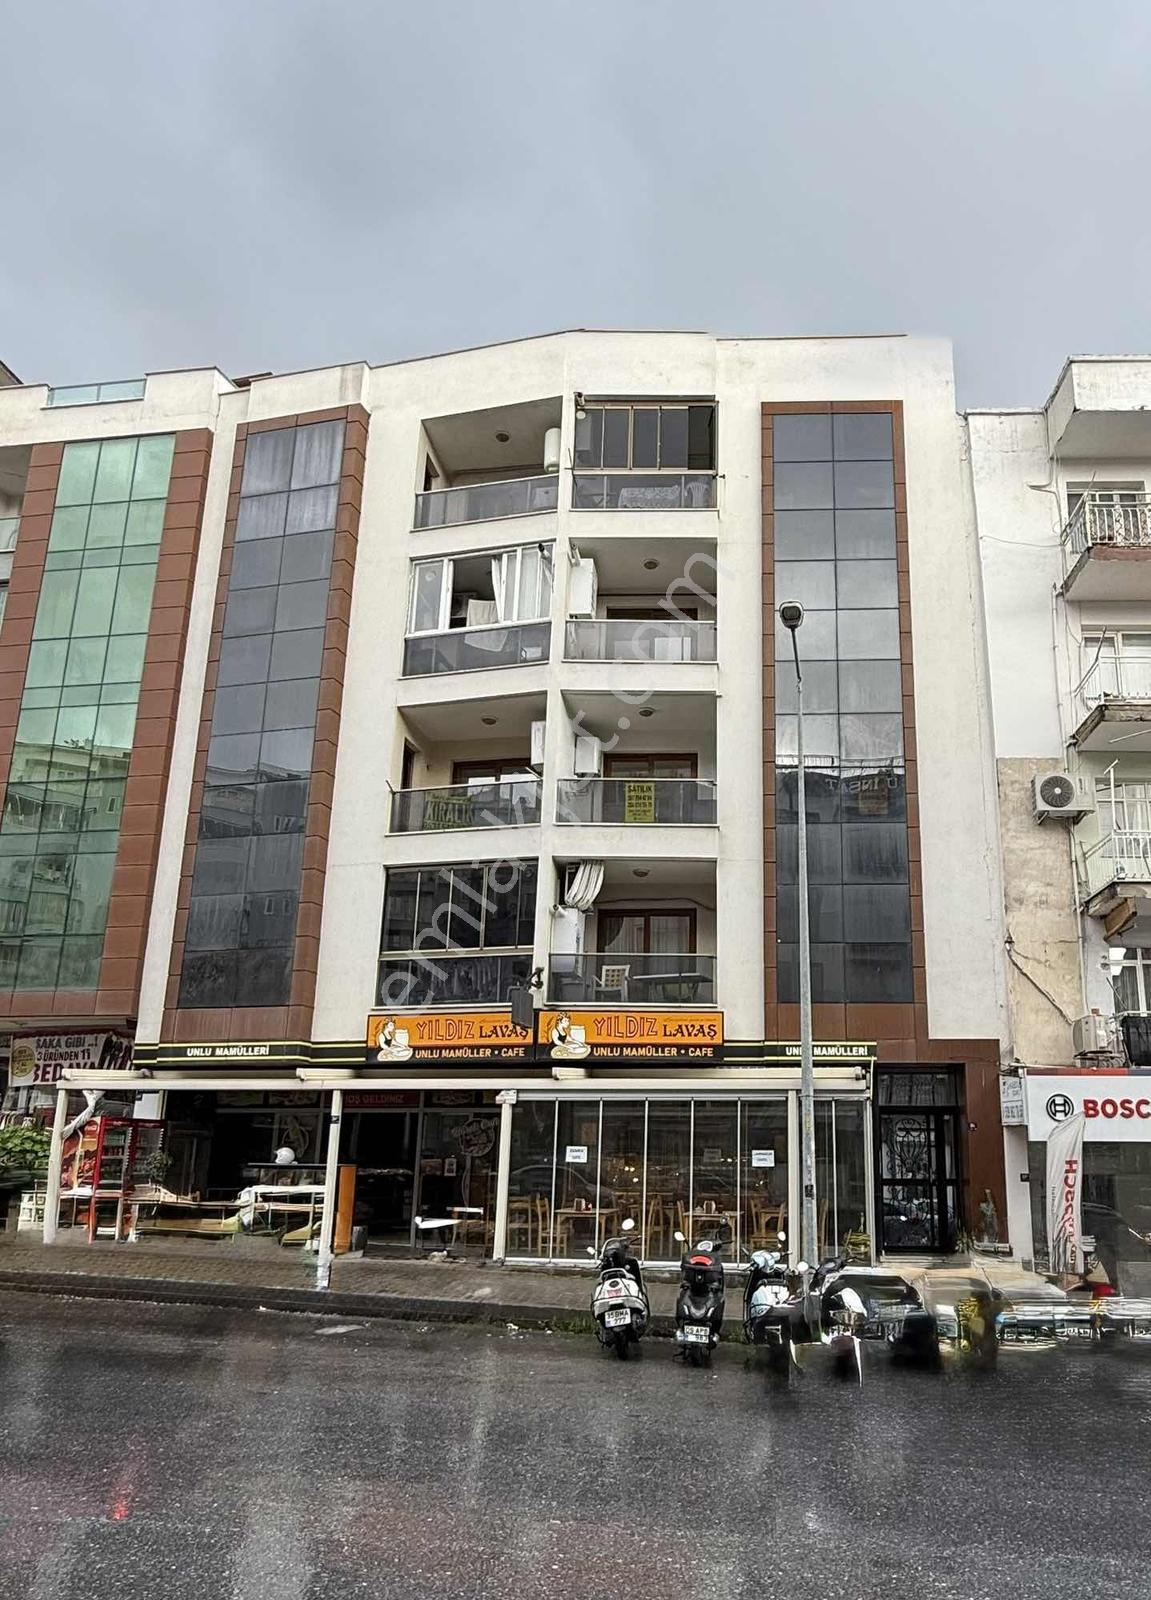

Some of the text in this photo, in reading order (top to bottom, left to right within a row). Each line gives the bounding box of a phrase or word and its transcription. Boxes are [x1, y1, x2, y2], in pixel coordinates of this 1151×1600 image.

[416, 1018, 529, 1041] YILDIZ LAVAŞ
[593, 1015, 717, 1041] YILDIZ LAVAŞ
[186, 1044, 269, 1056] UNLU MAMÜLLERİ
[415, 1046, 525, 1058] UNLU MAMÜLLER CAFE
[593, 1045, 714, 1057] UNLU MAMÜLLER CAFE
[813, 1044, 868, 1056] MAMÜLLERİ
